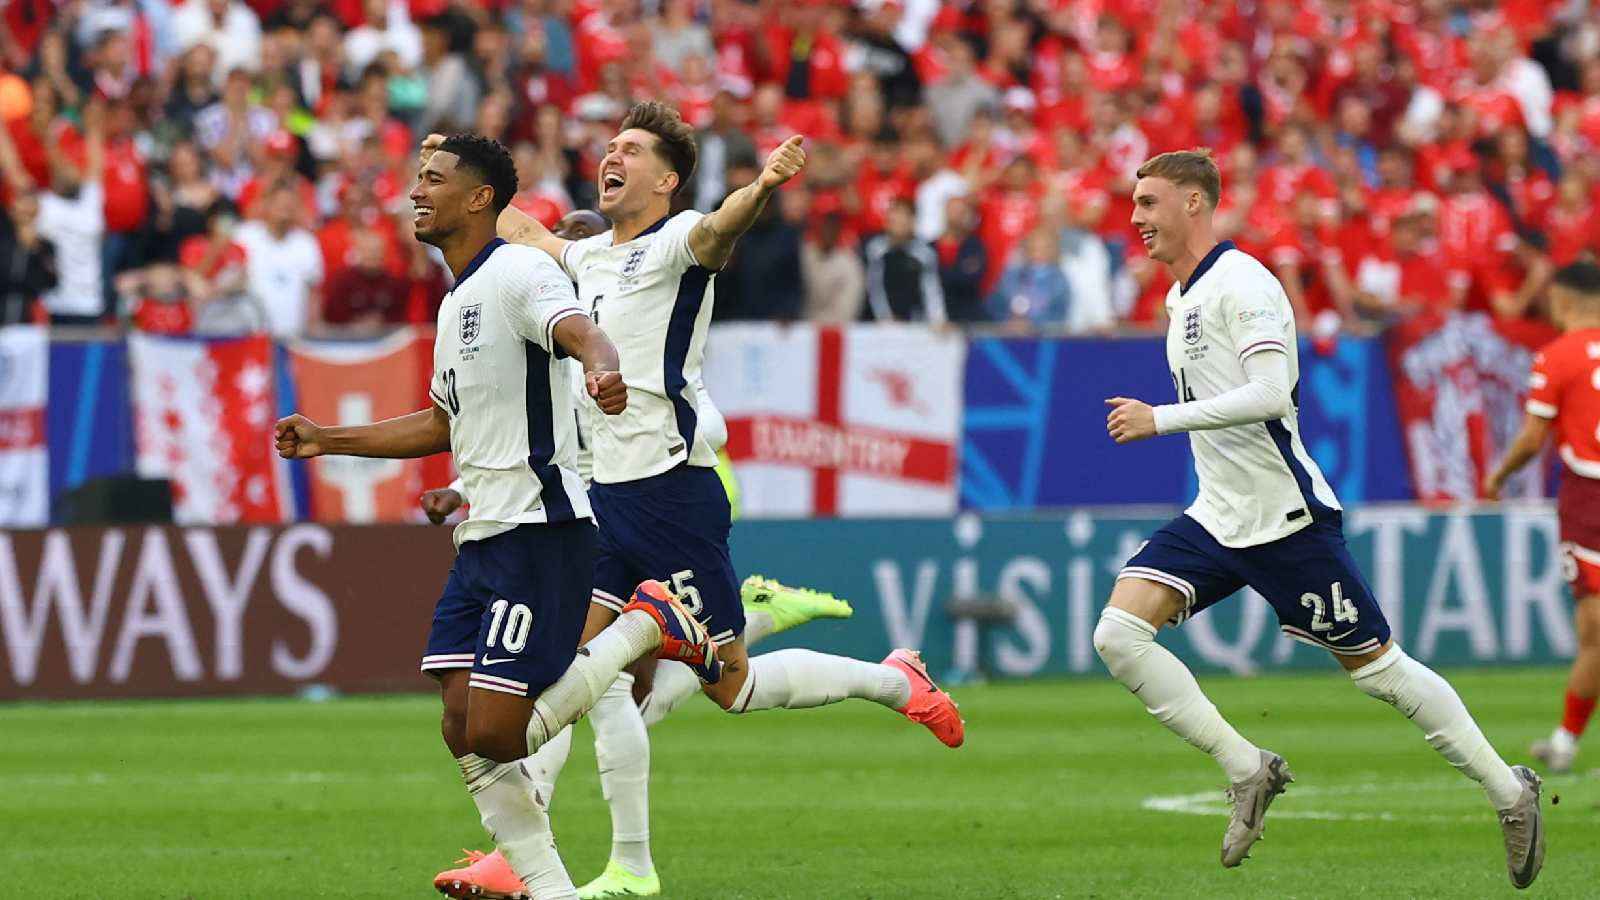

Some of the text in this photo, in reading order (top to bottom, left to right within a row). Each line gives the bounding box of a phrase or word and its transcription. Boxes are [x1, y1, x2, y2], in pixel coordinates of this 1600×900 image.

[0, 524, 338, 687] WAYS
[671, 569, 704, 616] 5
[1183, 503, 1578, 677] QTAR
[1300, 581, 1359, 632] 24
[486, 599, 533, 654] 10
